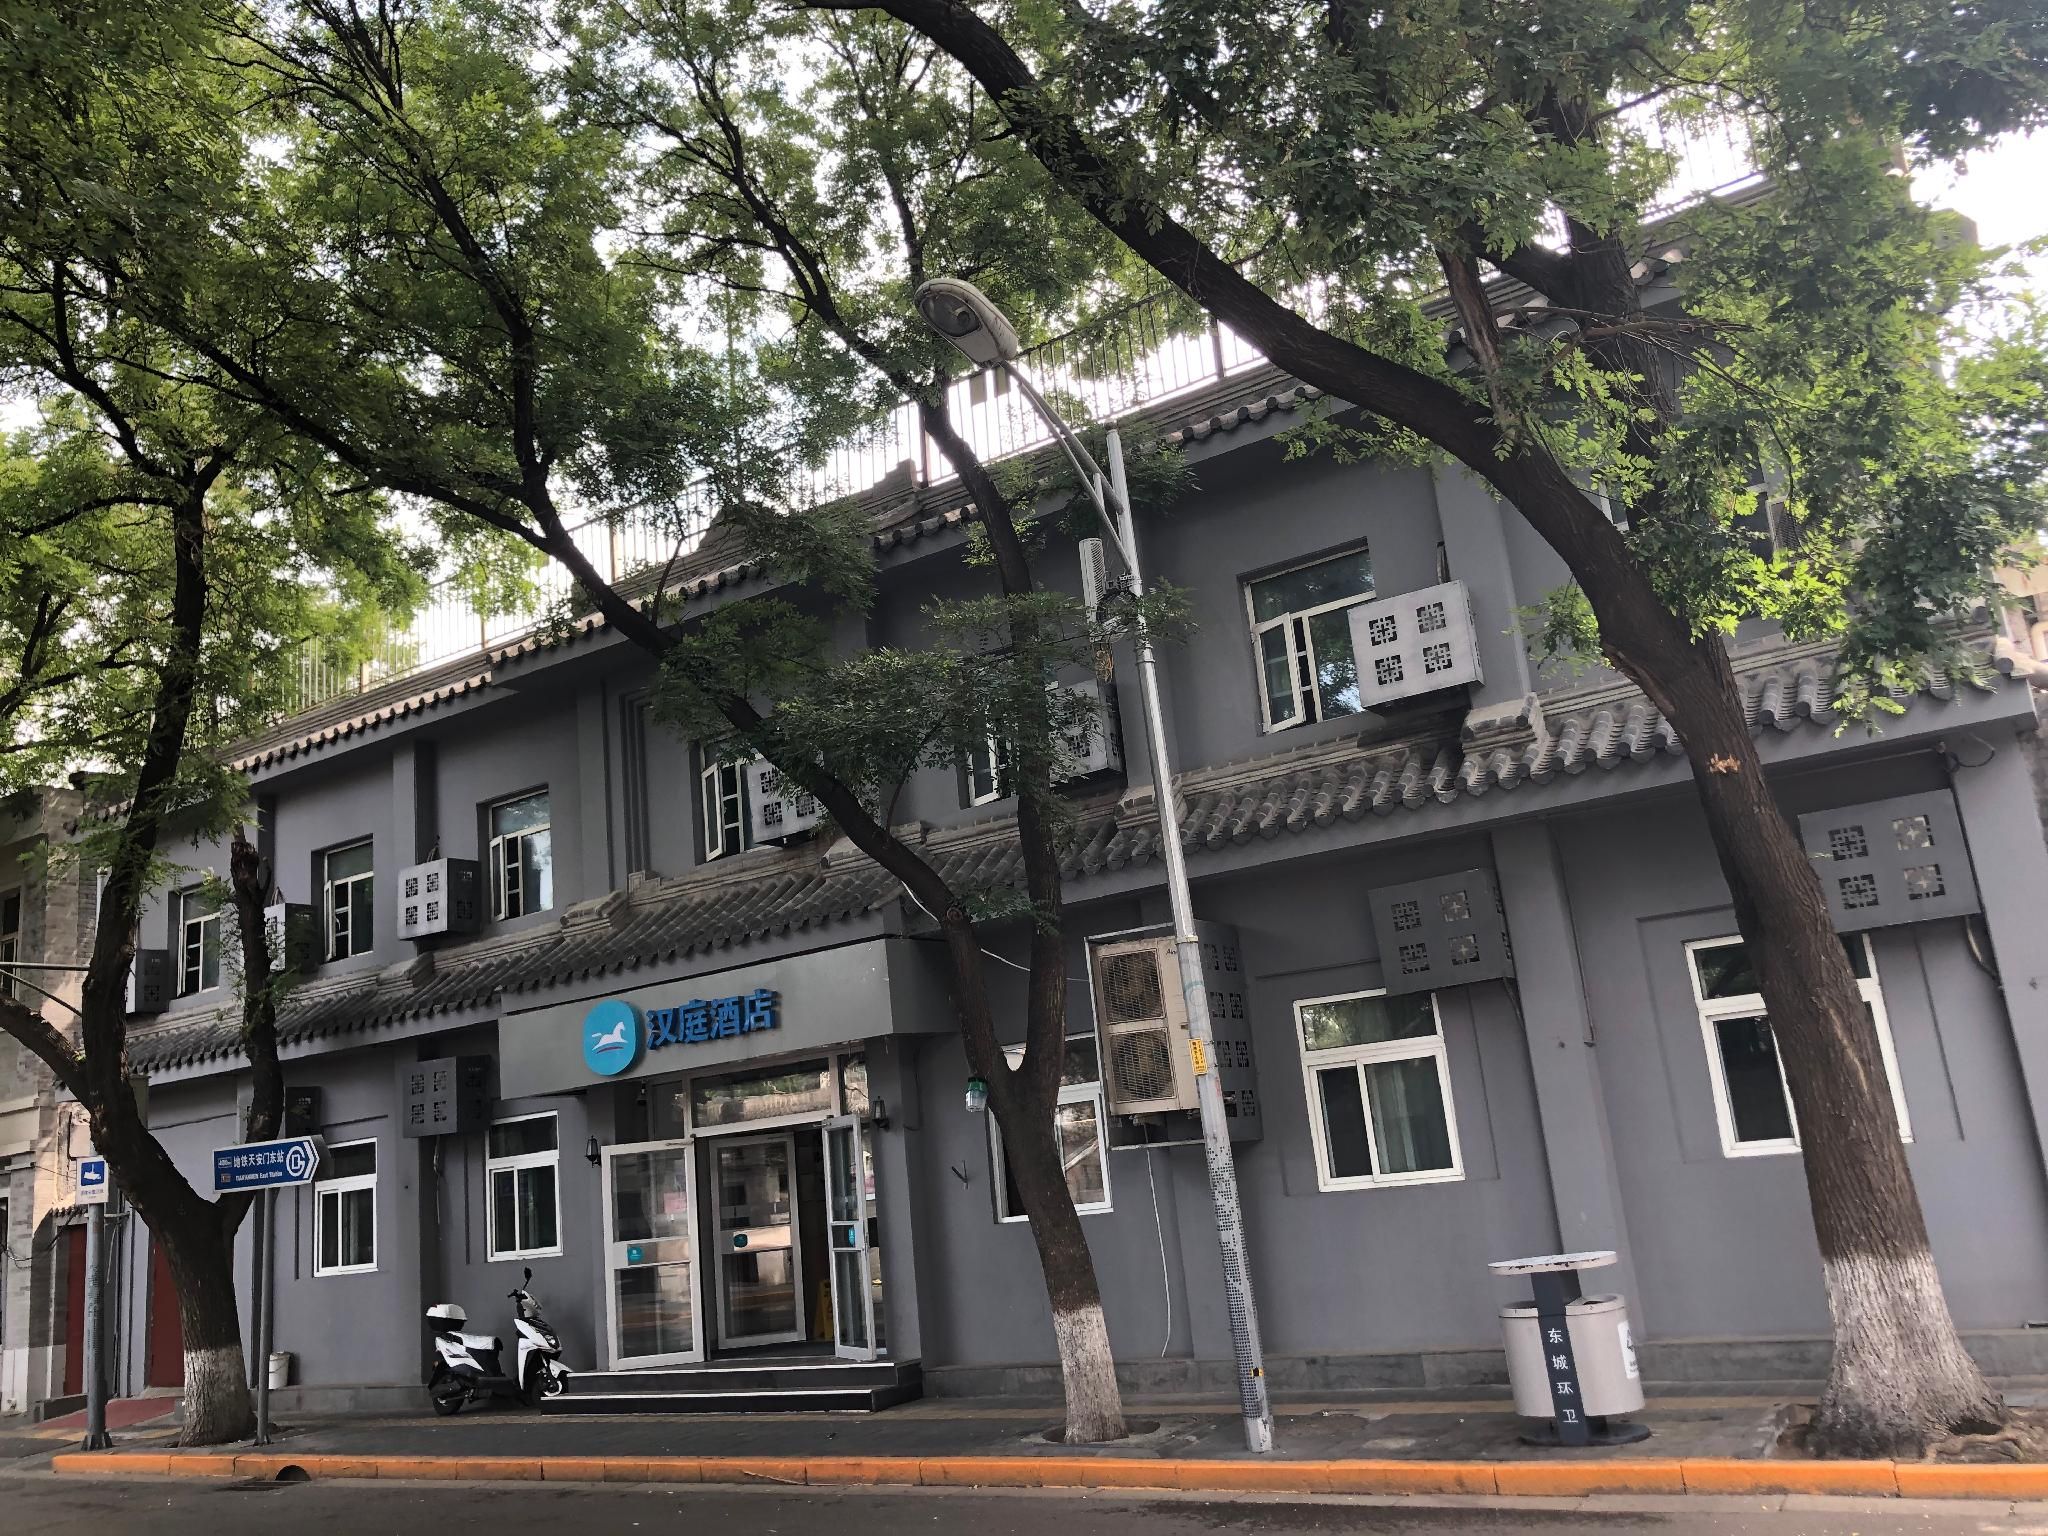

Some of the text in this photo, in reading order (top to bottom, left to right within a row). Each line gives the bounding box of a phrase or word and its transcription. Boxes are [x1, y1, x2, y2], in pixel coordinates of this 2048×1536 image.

[646, 988, 780, 1050] 汉庭酒店
[234, 1150, 285, 1169] 地铁天安门东站
[1547, 1327, 1579, 1423] 东城环卫
